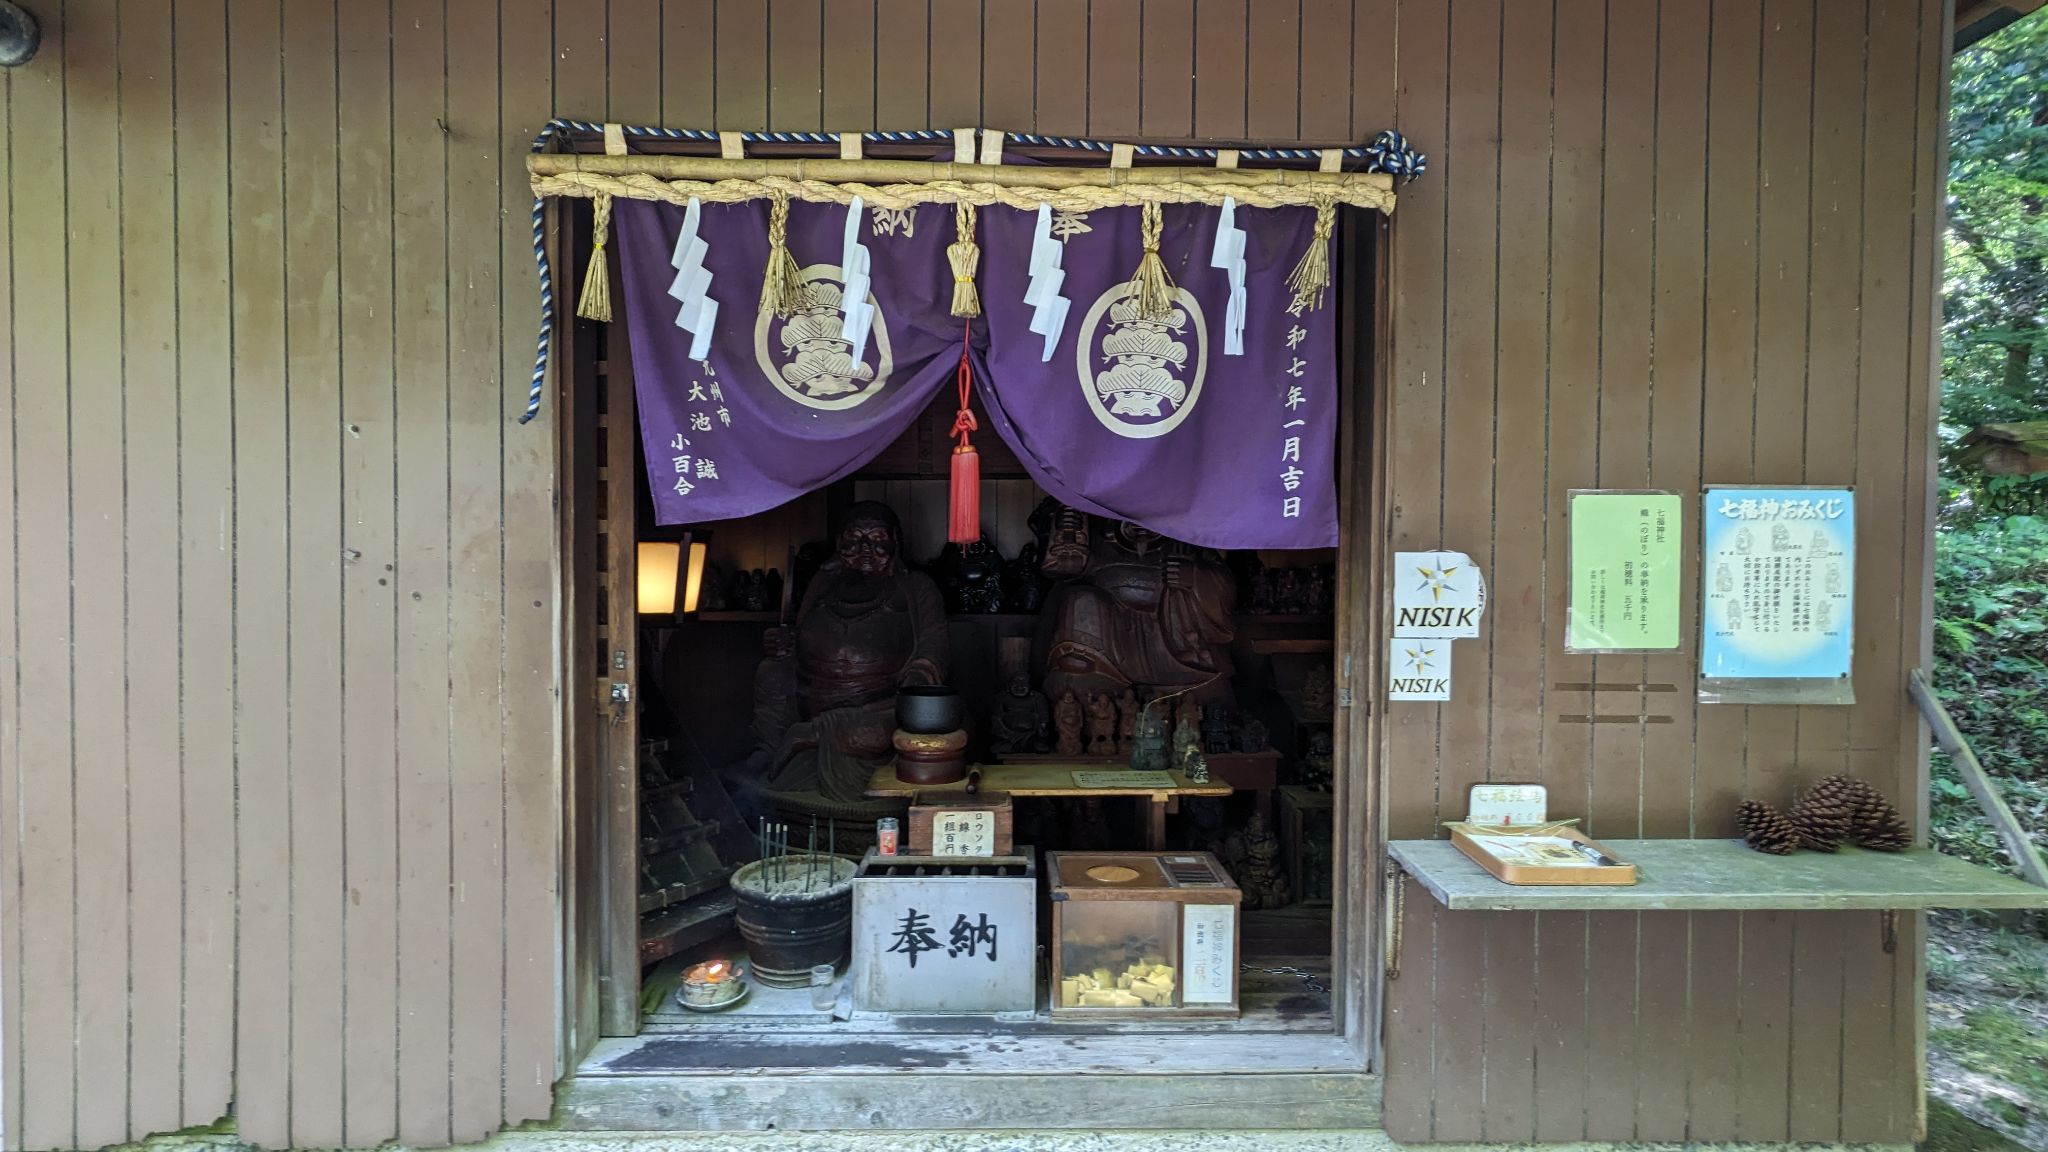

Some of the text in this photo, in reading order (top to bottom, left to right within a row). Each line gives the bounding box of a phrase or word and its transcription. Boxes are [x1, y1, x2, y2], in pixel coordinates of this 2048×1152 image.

[872, 205, 917, 238] 納
[1280, 294, 1308, 518] 令和七年一月吉日
[671, 433, 695, 496] 小百合
[1718, 499, 1845, 521] 七福神おみくじ
[975, 812, 984, 854] ロウソク
[886, 907, 998, 969] 奉納
